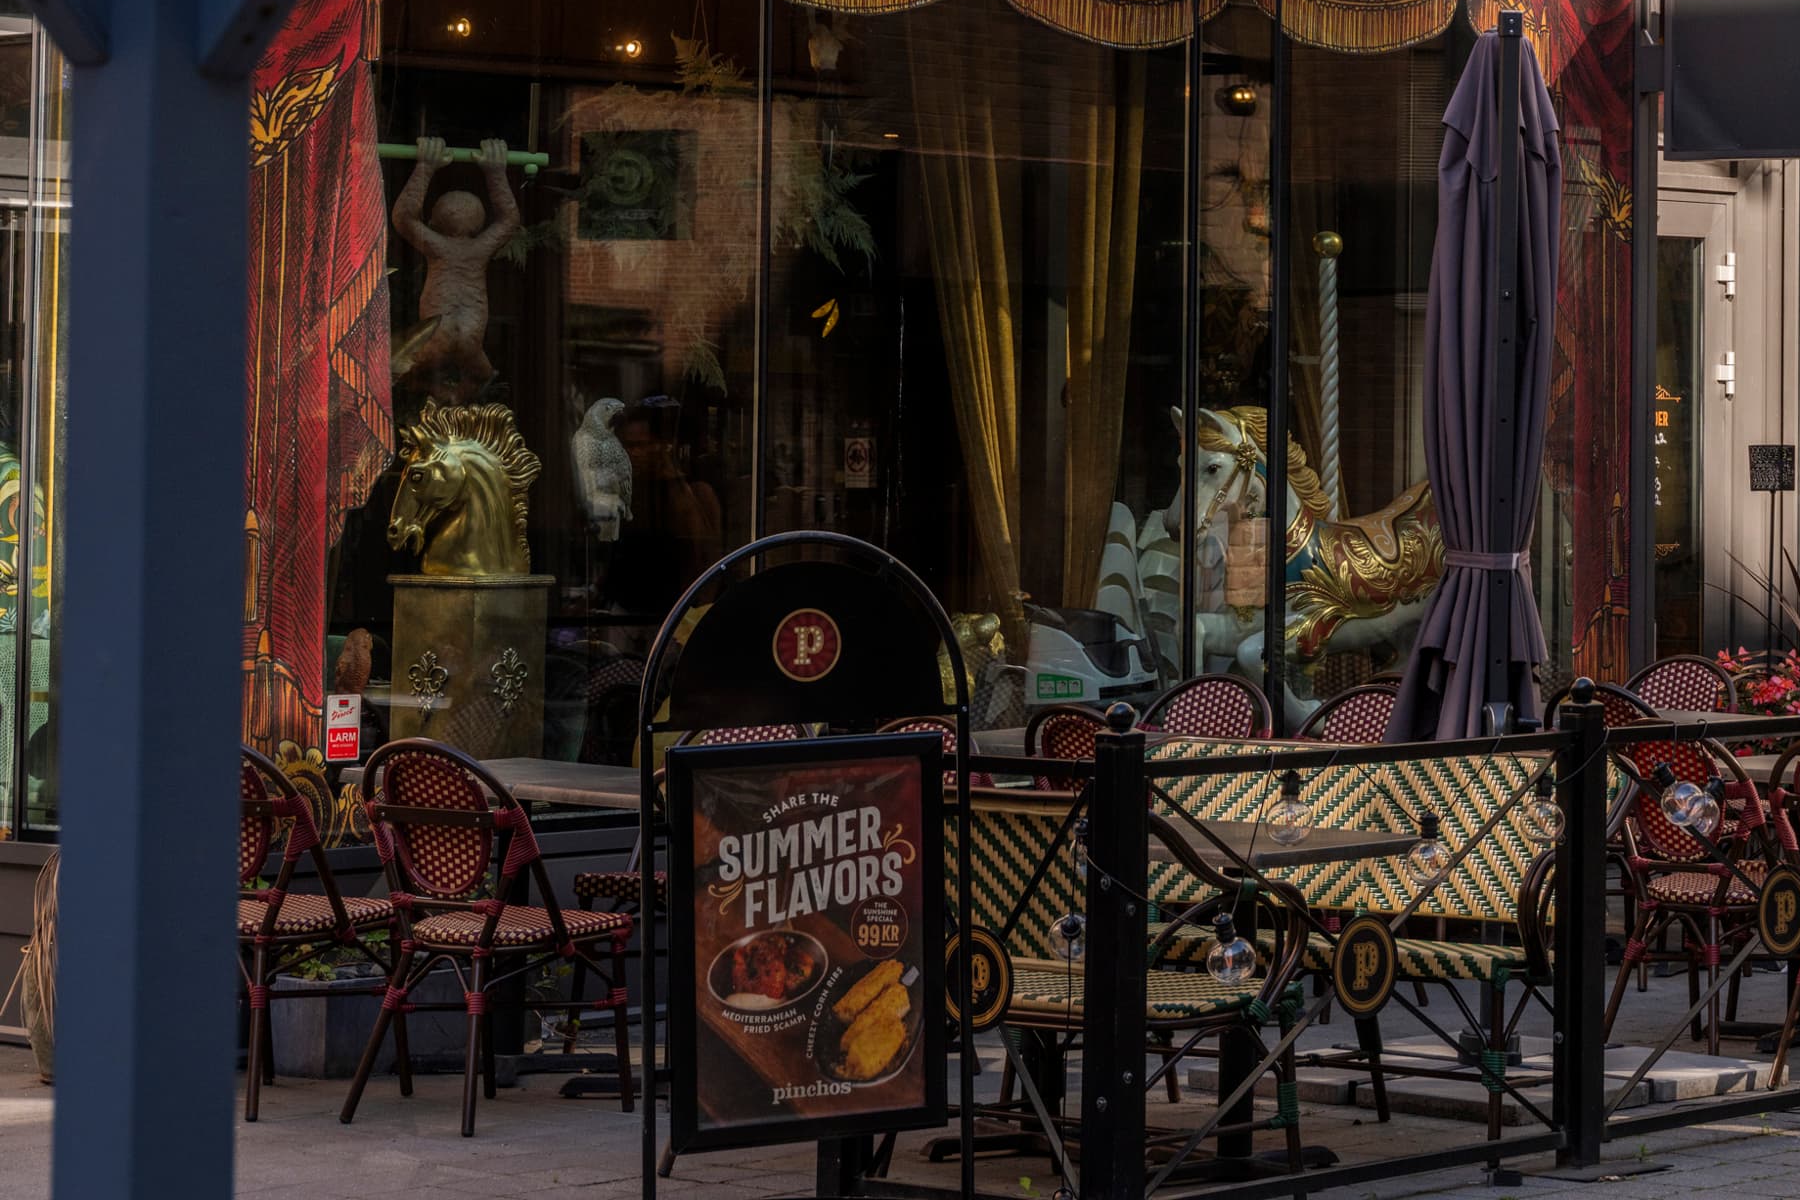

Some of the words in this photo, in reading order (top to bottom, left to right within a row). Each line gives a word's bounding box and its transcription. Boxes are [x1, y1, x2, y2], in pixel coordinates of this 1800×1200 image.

[330, 732, 356, 742] LARM
[762, 794, 806, 824] SHARE
[812, 792, 840, 808] THE
[718, 806, 883, 882] SUMMER
[744, 851, 904, 929] FLAVORS
[863, 908, 898, 917] SUNSHINE
[866, 915, 894, 923] SPECIAL
[721, 1008, 798, 1025] MEDITERRANEAN
[743, 1024, 771, 1034] FRIED
[773, 1013, 807, 1032] SCAMPI
[805, 1020, 820, 1060] CHEEZY
[814, 988, 829, 1018] CORN
[826, 966, 844, 988] RIBS
[772, 1080, 852, 1105] pinchos
